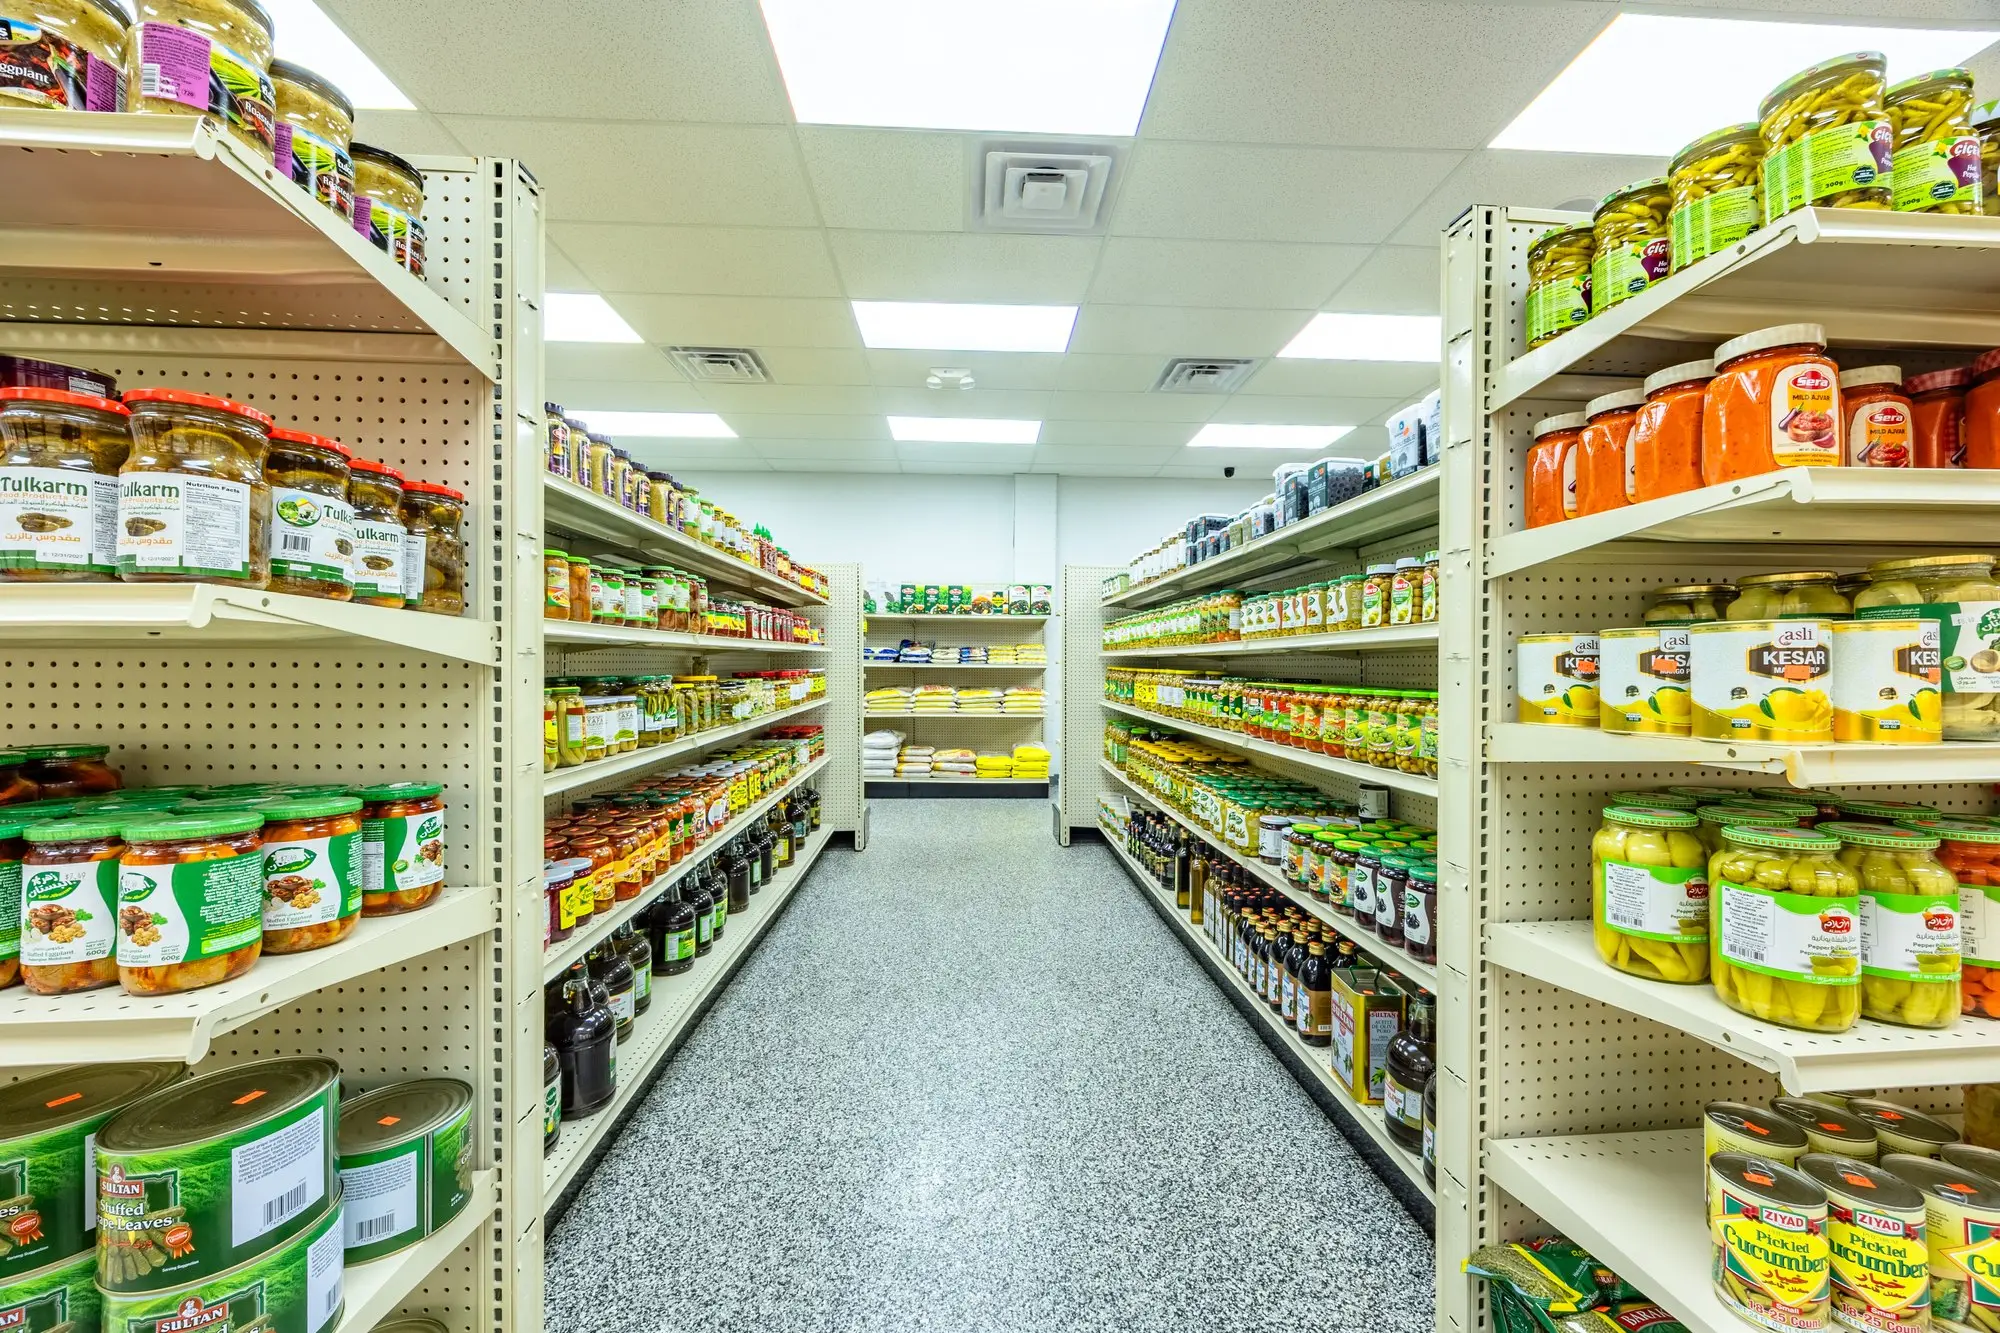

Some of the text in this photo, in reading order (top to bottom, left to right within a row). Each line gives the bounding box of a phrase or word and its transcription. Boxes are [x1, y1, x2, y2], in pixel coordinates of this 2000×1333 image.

[1796, 376, 1830, 388] Sera
[1873, 411, 1904, 422] Sera
[0, 477, 88, 497] Tulkarm
[186, 481, 240, 493] Nutrition Facts
[354, 527, 399, 543] ulkarm
[1780, 628, 1813, 644] asli
[1763, 651, 1825, 664] KESAR
[101, 1181, 140, 1195] SULTAN
[99, 1199, 145, 1216] Stuffed
[116, 1216, 173, 1231] Leaves
[1764, 1209, 1804, 1228] ZIYAD
[1858, 1212, 1901, 1231] ZIYAD
[1756, 1228, 1810, 1254] Pickled
[1849, 1232, 1907, 1259] Pickled
[1829, 1237, 1929, 1278] ucumbers
[1760, 1269, 1809, 1285] خيار
[1854, 1272, 1906, 1290] خيار
[1748, 1300, 1822, 1329] 18-25 Count
[1775, 1302, 1800, 1315] Small
[1841, 1303, 1882, 1327] 18-25
[1872, 1306, 1897, 1320] Small
[160, 1306, 224, 1333] SULTAN
